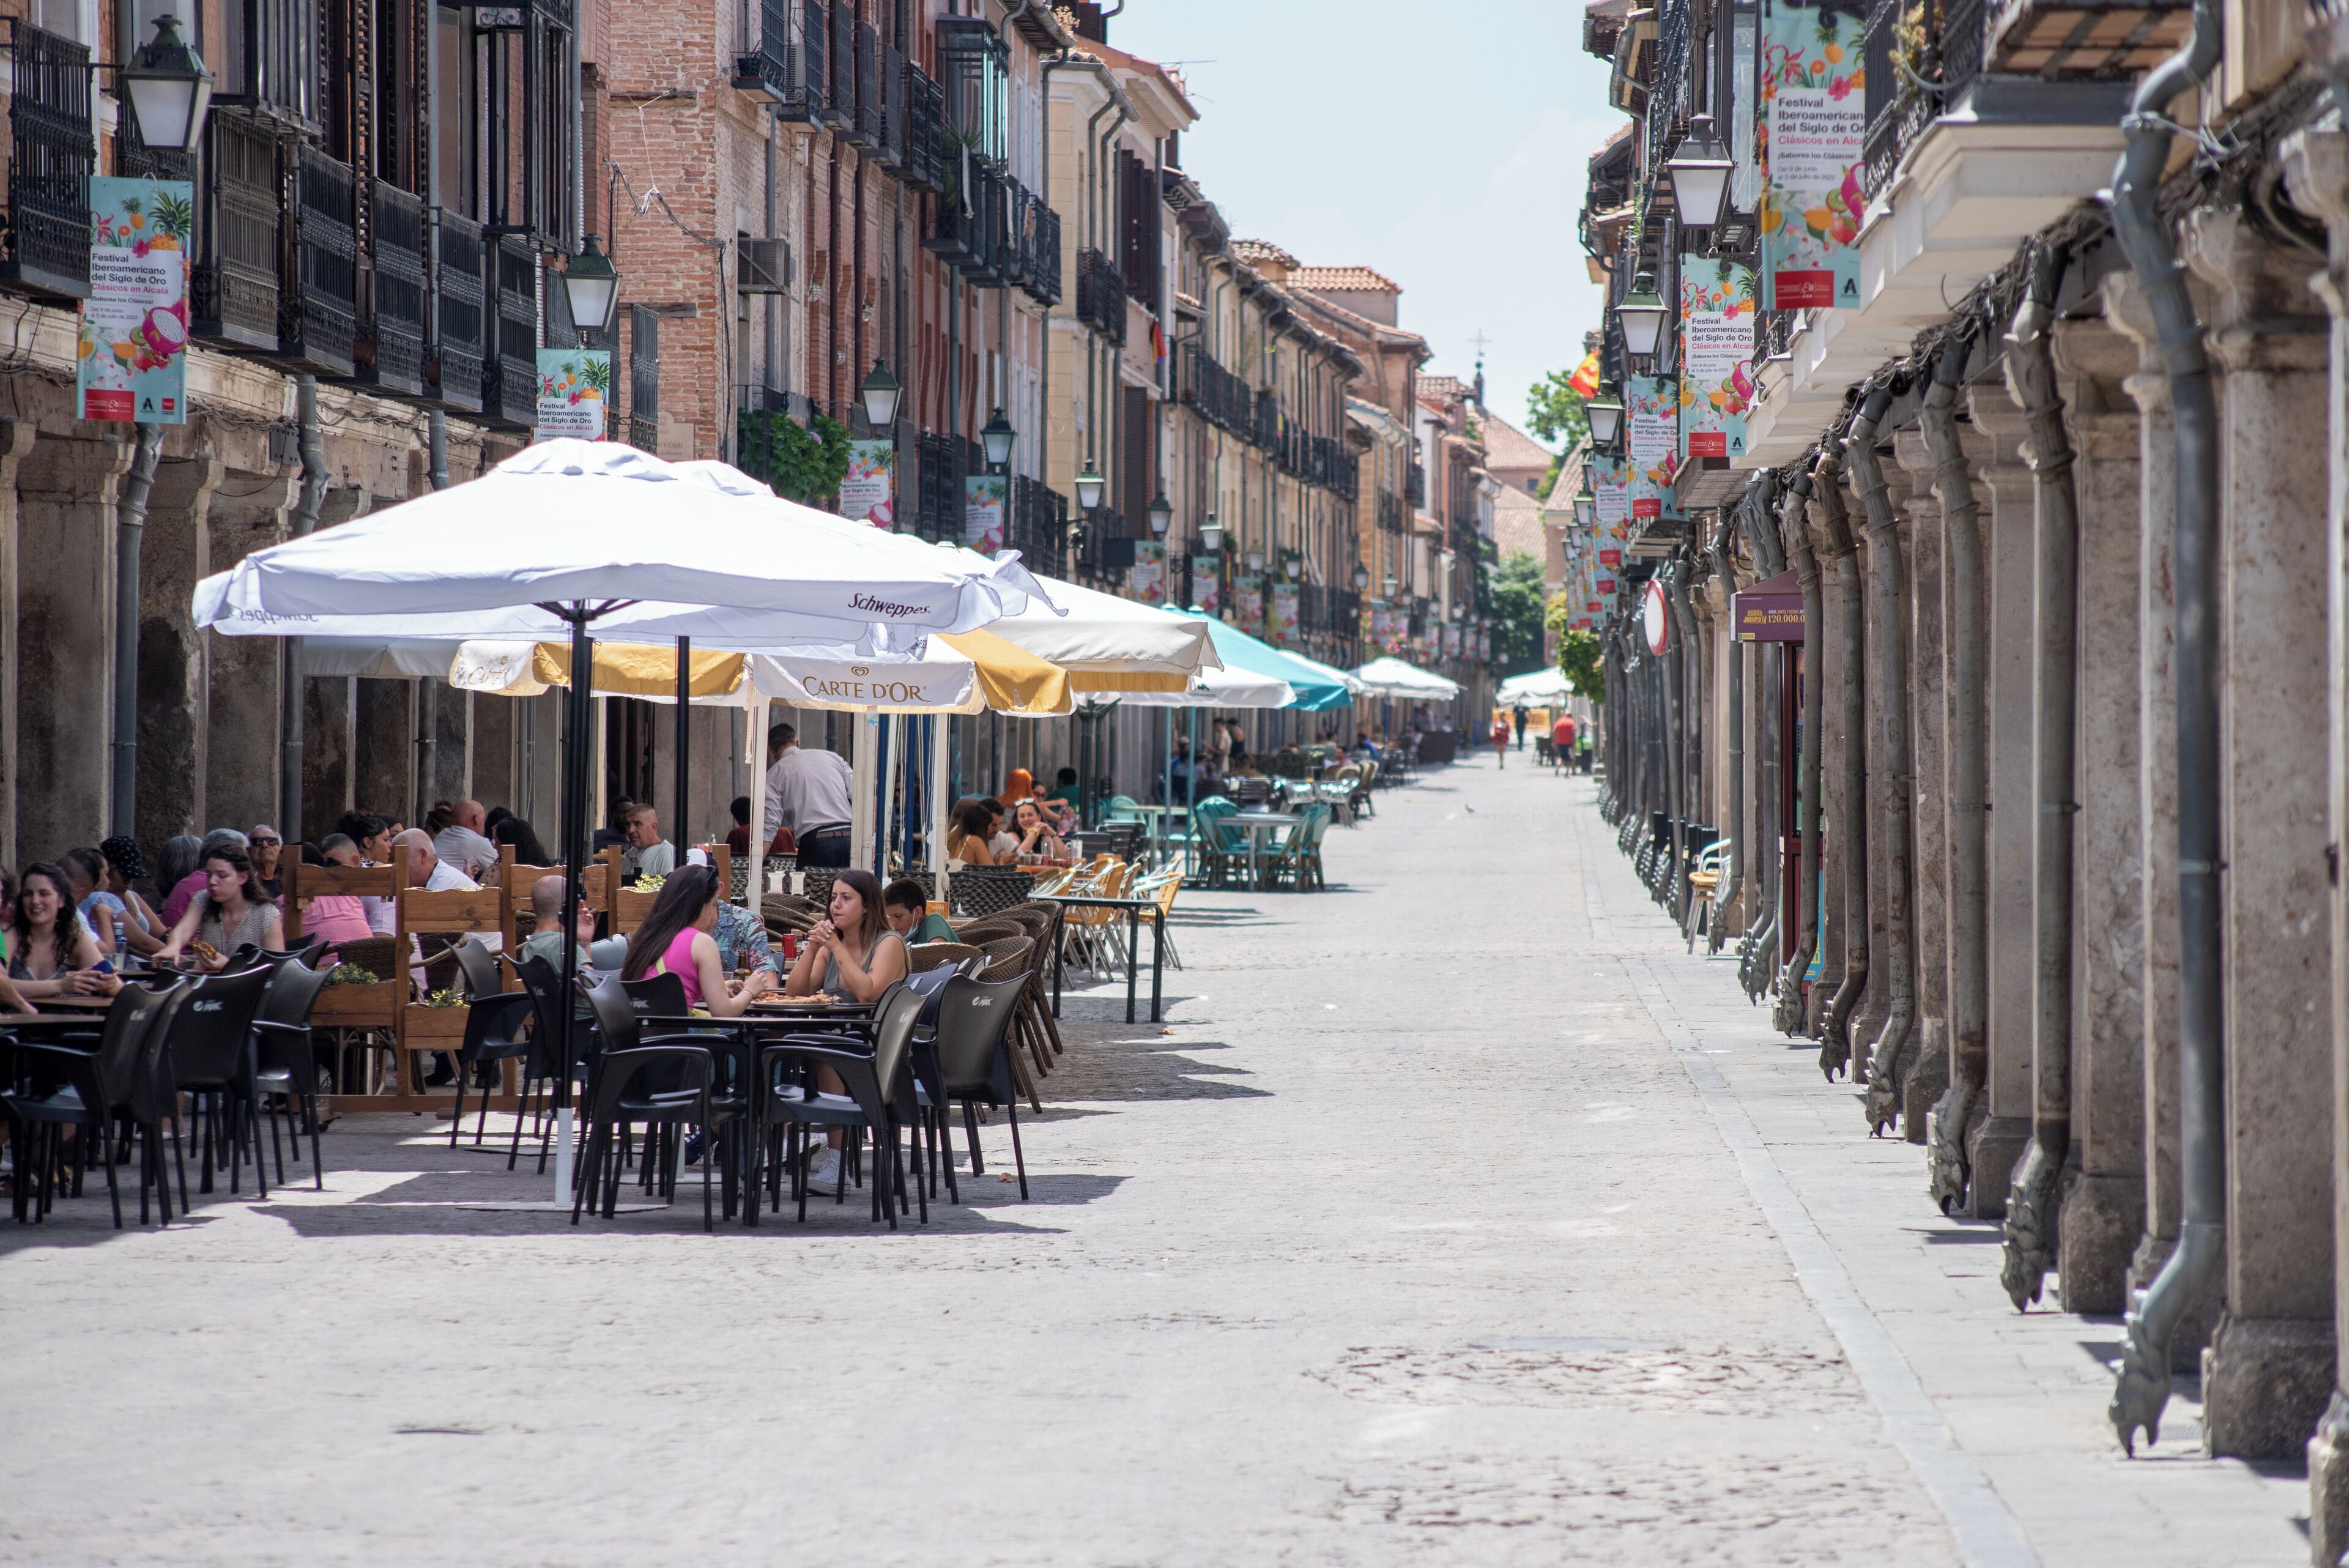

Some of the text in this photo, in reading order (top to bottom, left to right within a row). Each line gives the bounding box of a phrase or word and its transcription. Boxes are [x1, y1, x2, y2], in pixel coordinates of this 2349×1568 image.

[1779, 97, 1823, 107] Festival
[1779, 110, 1865, 120] Iberoamerican
[1778, 123, 1865, 135] del Siglo de Or
[1778, 135, 1823, 144] Clásicos
[1842, 136, 1865, 144] Alca
[92, 253, 128, 262] Festival
[92, 264, 165, 274] Iberoamericano
[109, 274, 132, 283] Siglo
[92, 283, 128, 291] Clásicos
[143, 286, 168, 294] Alcalá
[848, 593, 930, 617] Schweppes
[1768, 614, 1805, 623] 120.000.0
[803, 676, 932, 702] CARTE D'OR
